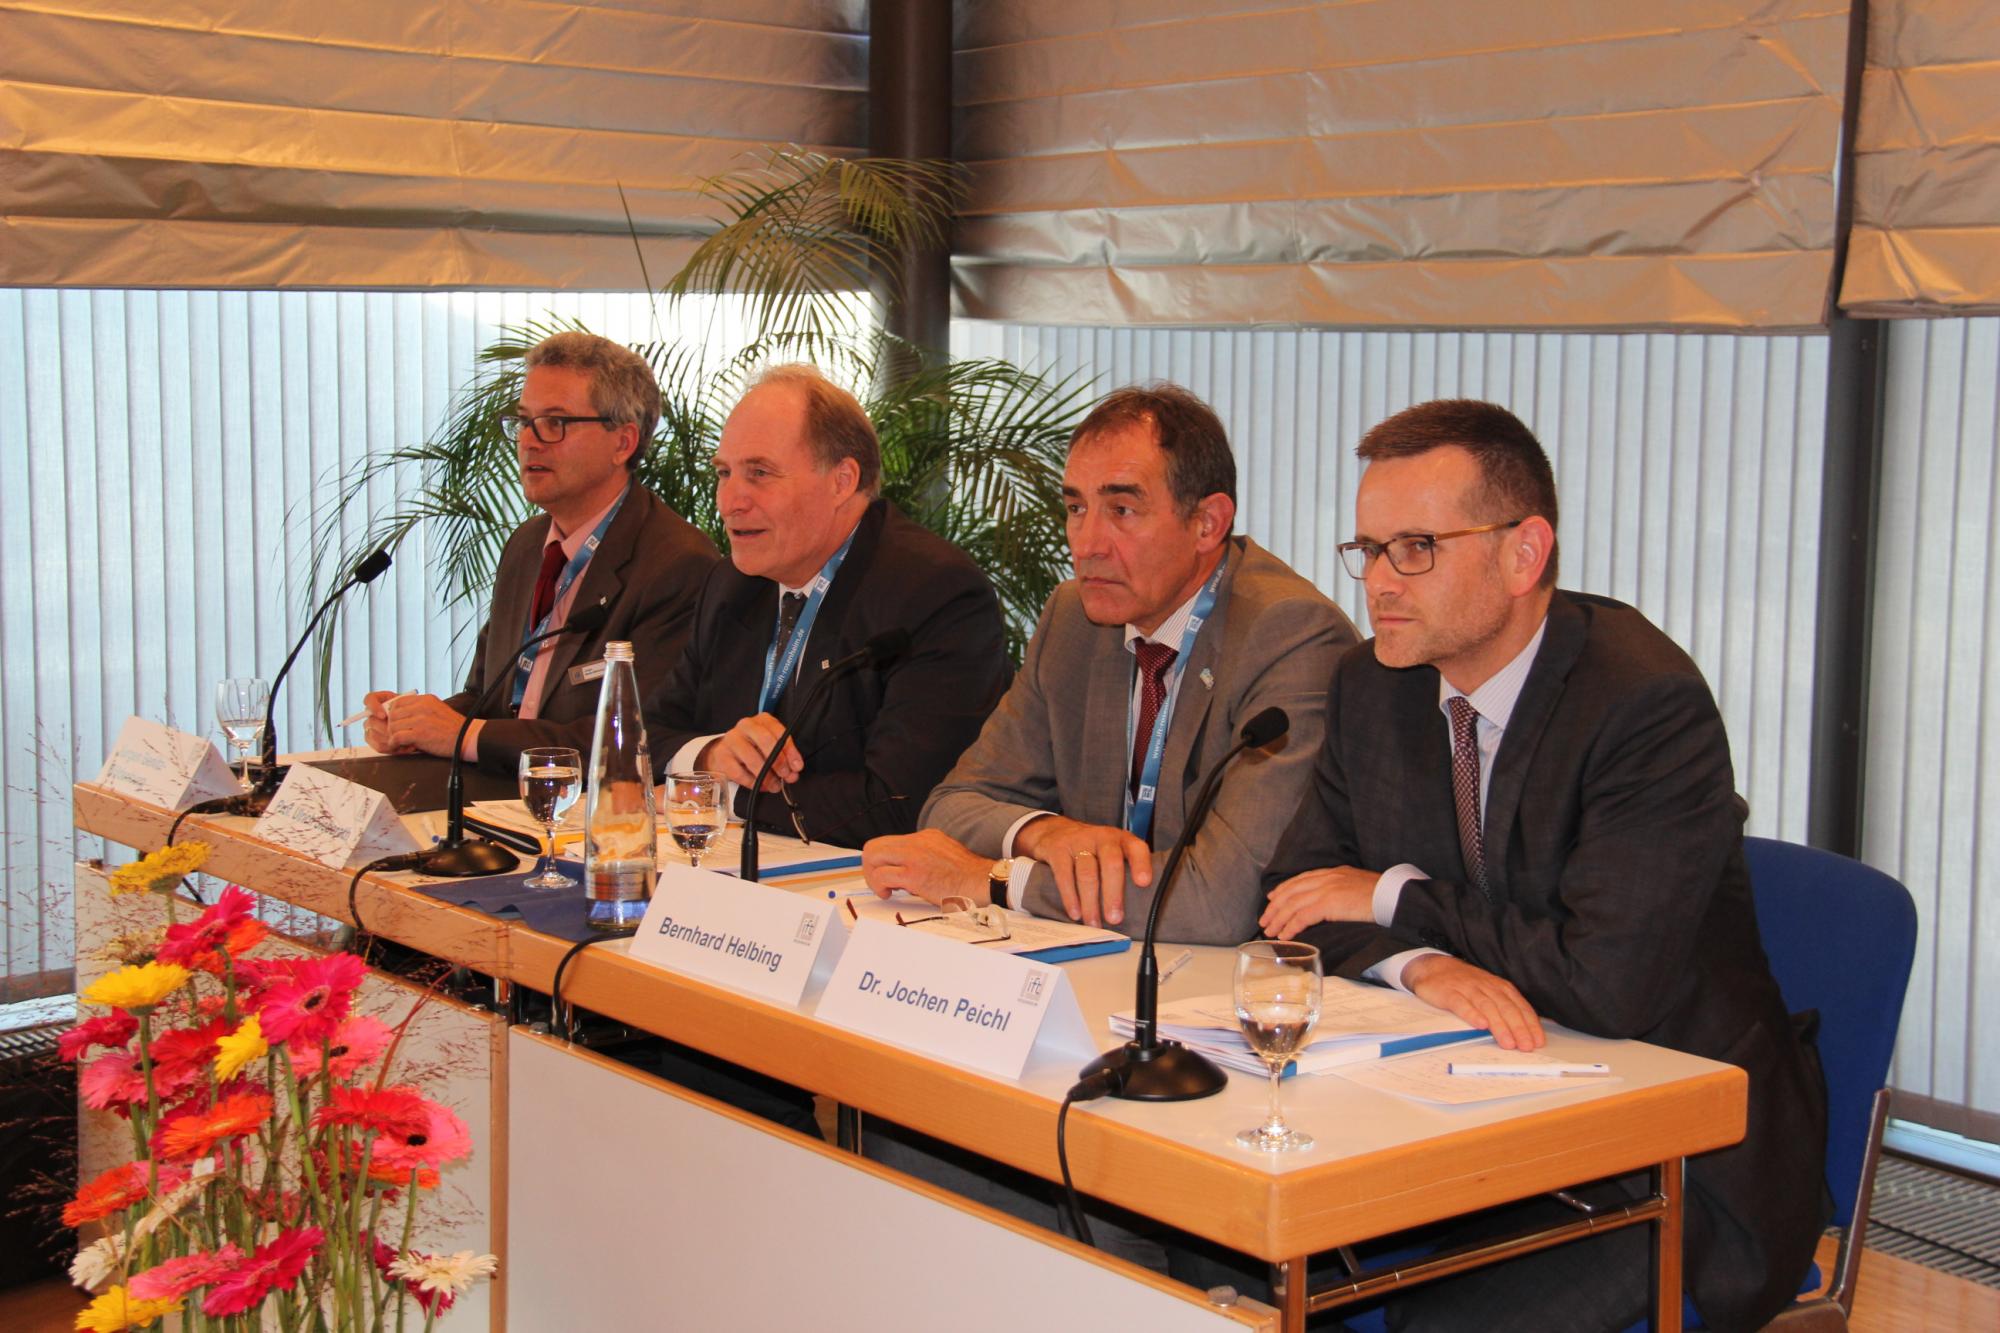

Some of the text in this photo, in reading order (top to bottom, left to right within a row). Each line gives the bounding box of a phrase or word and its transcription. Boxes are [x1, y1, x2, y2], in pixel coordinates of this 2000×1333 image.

[658, 916, 783, 973] Bernhard Helbing
[858, 971, 1012, 1032] Dr. Jochen Peichl
